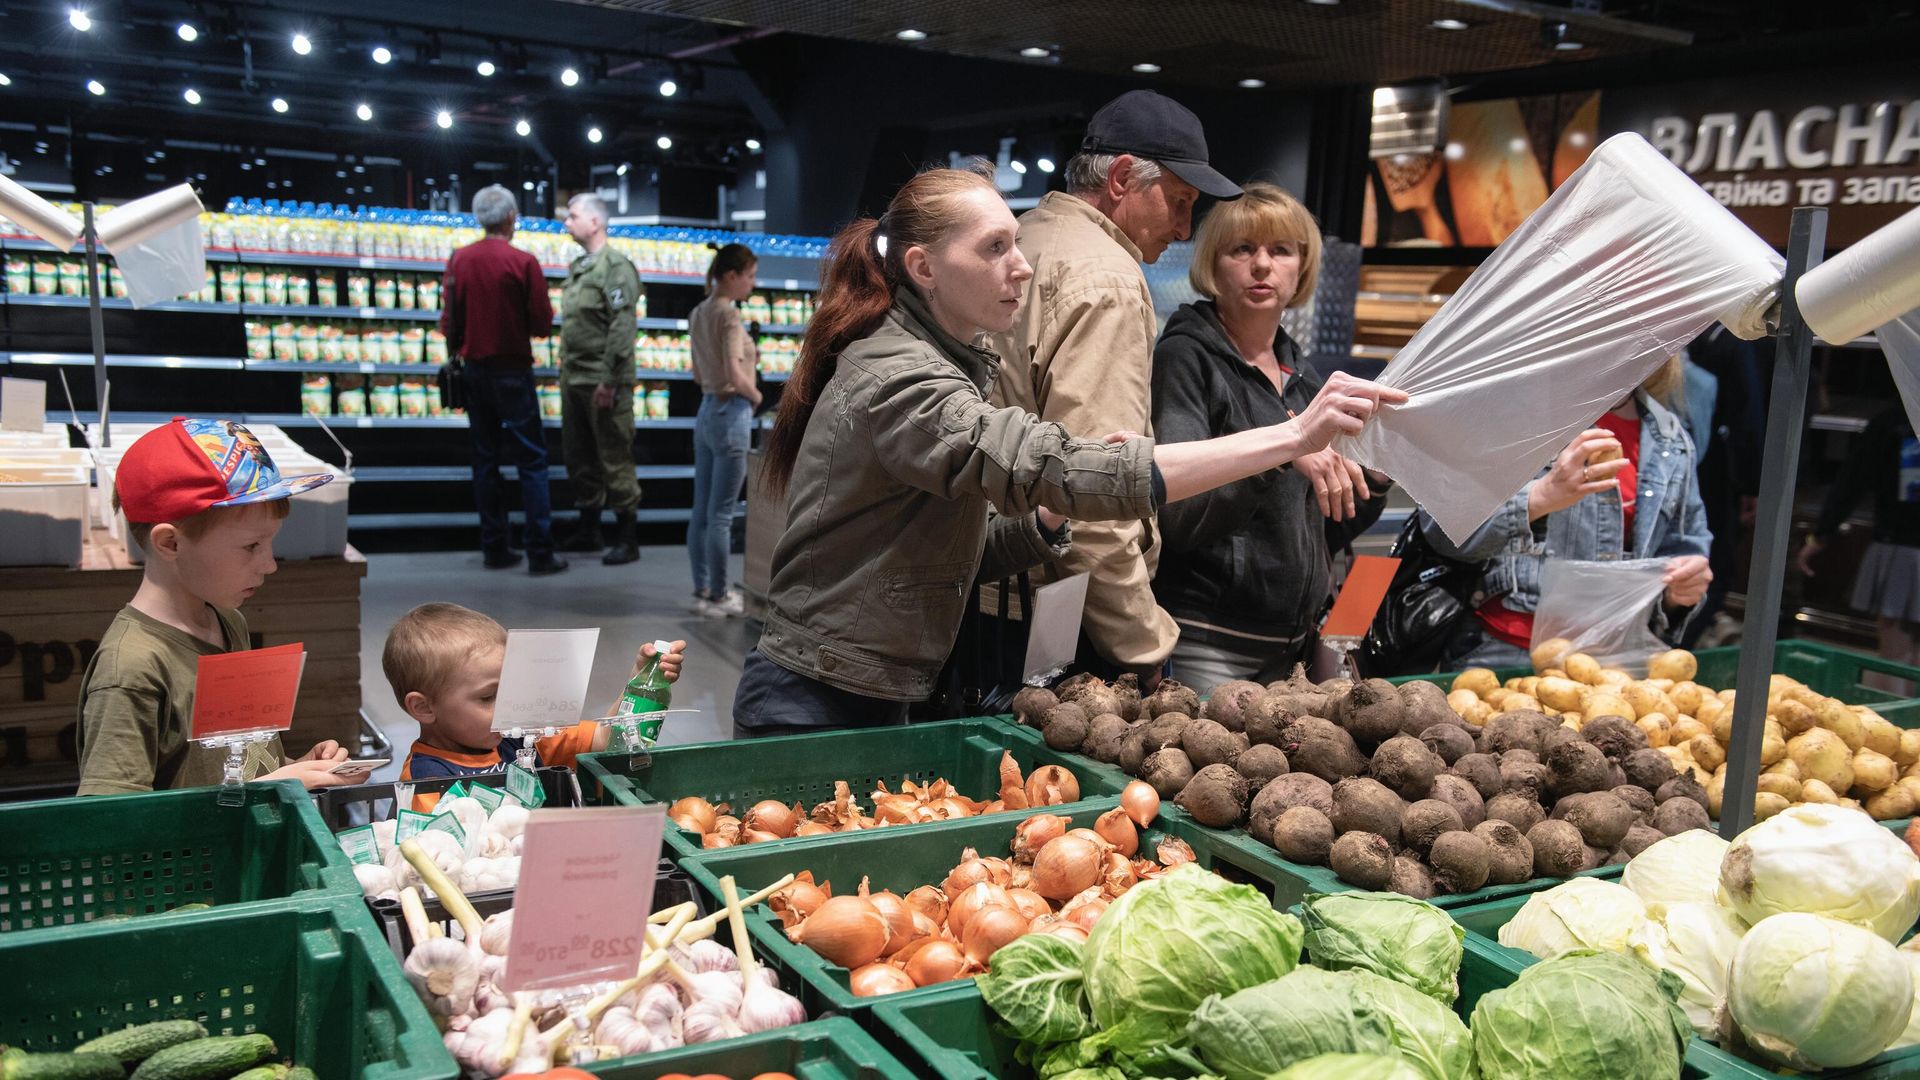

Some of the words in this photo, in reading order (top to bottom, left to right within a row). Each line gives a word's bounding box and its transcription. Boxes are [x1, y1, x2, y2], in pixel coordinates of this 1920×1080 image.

[1651, 103, 1920, 172] ВЛАСНА
[1797, 177, 1835, 205] та
[1840, 176, 1920, 205] запа
[610, 287, 624, 305] Z
